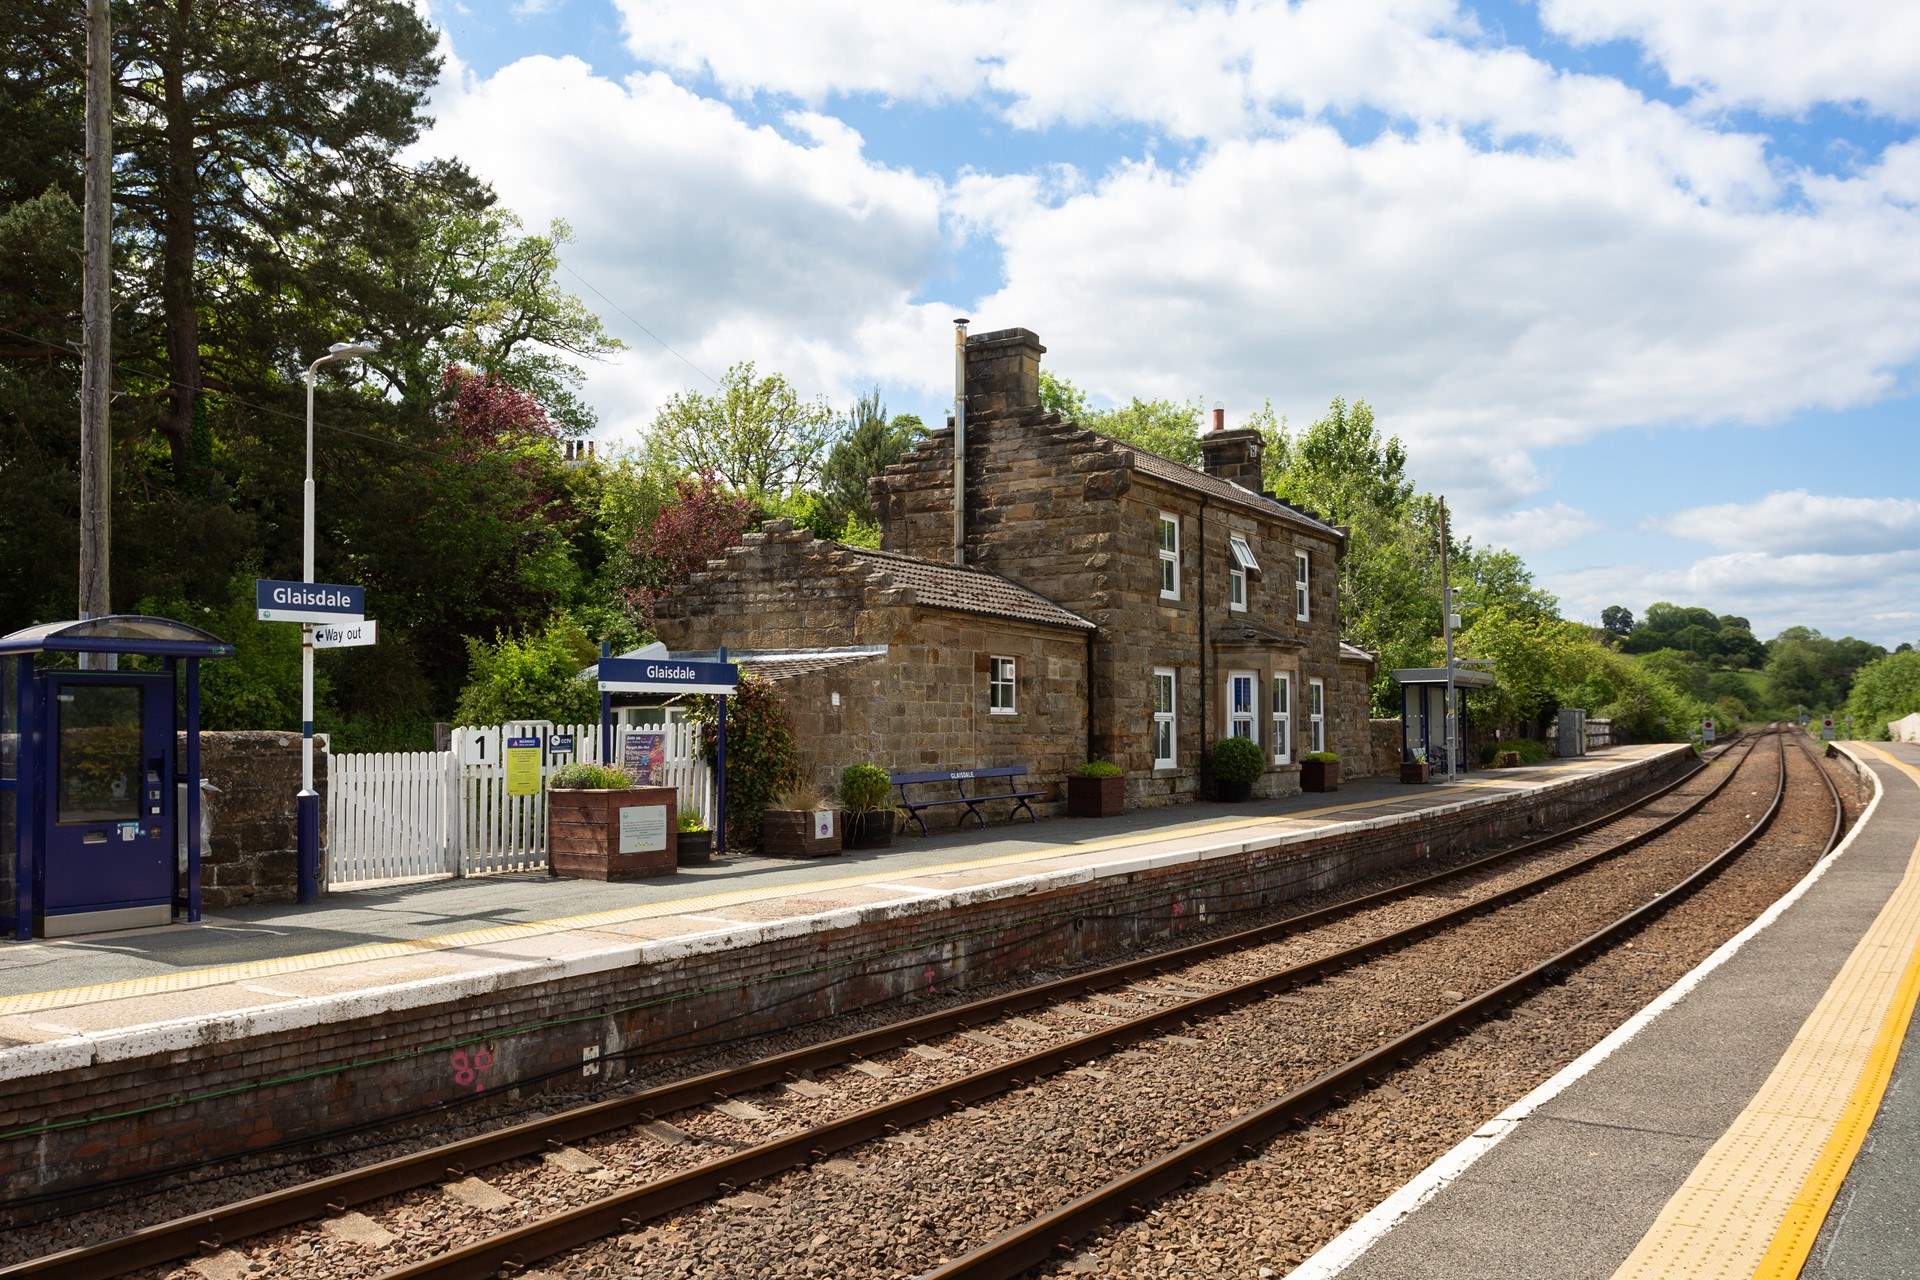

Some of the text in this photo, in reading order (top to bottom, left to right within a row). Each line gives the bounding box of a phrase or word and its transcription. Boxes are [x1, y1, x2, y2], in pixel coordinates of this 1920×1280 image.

[273, 587, 351, 608] Glaisdale
[325, 627, 361, 643] Way out
[646, 665, 696, 680] Glaisdale
[475, 735, 485, 760] 1
